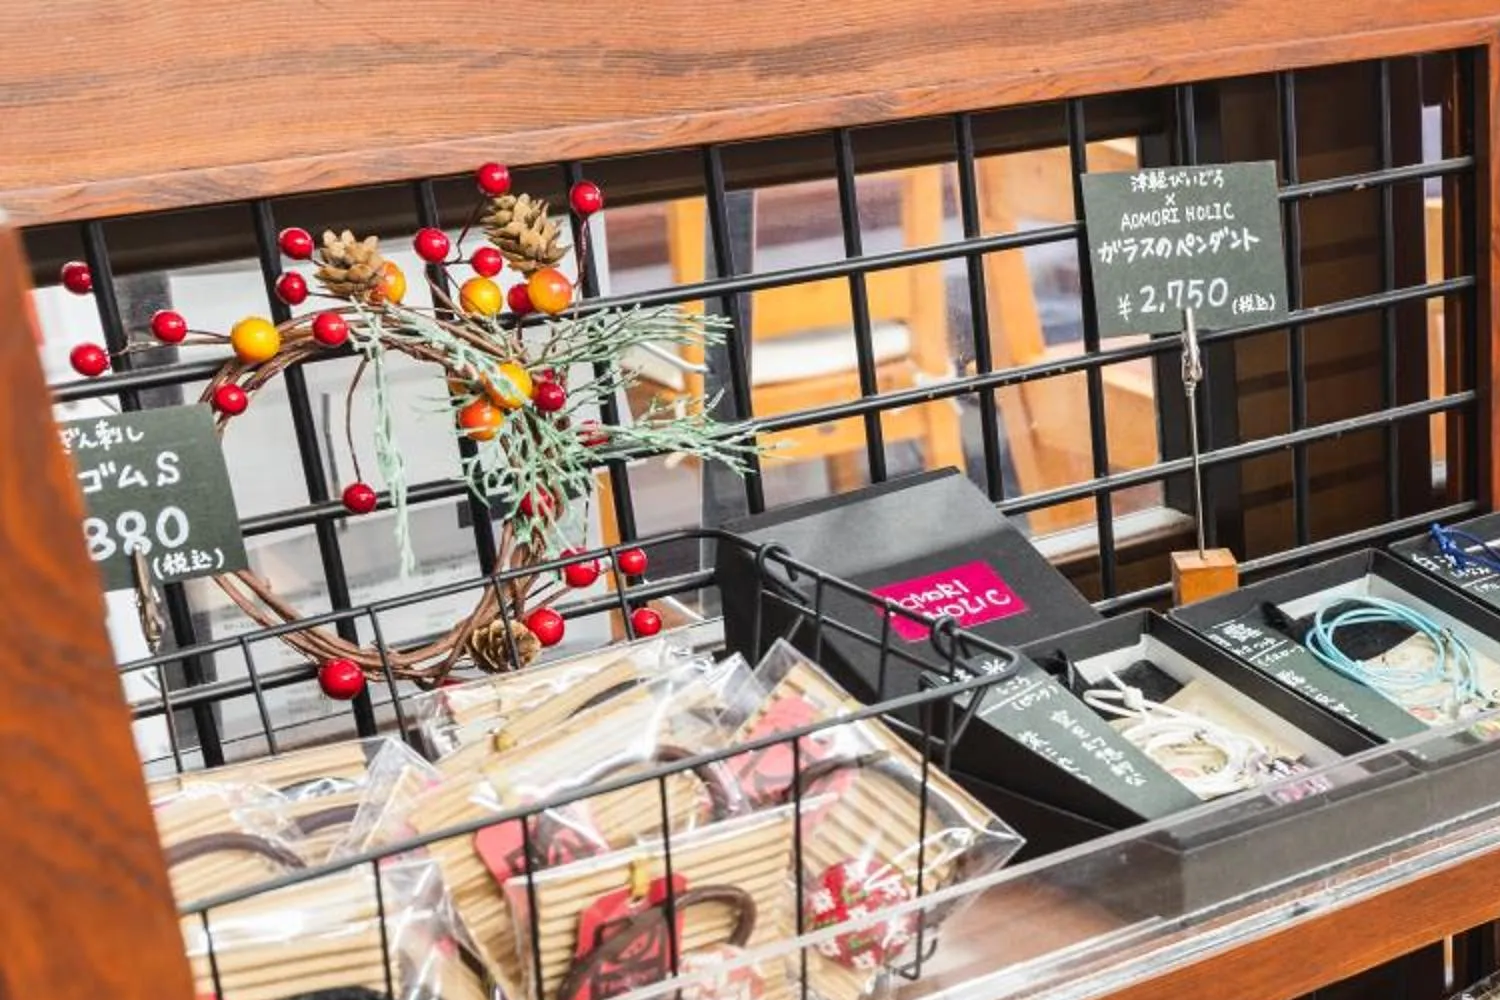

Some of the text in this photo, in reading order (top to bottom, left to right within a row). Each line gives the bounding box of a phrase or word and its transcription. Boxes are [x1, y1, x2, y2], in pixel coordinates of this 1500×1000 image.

[1121, 202, 1235, 232] AOMORI HOLIC
[152, 548, 226, 580] (税込)
